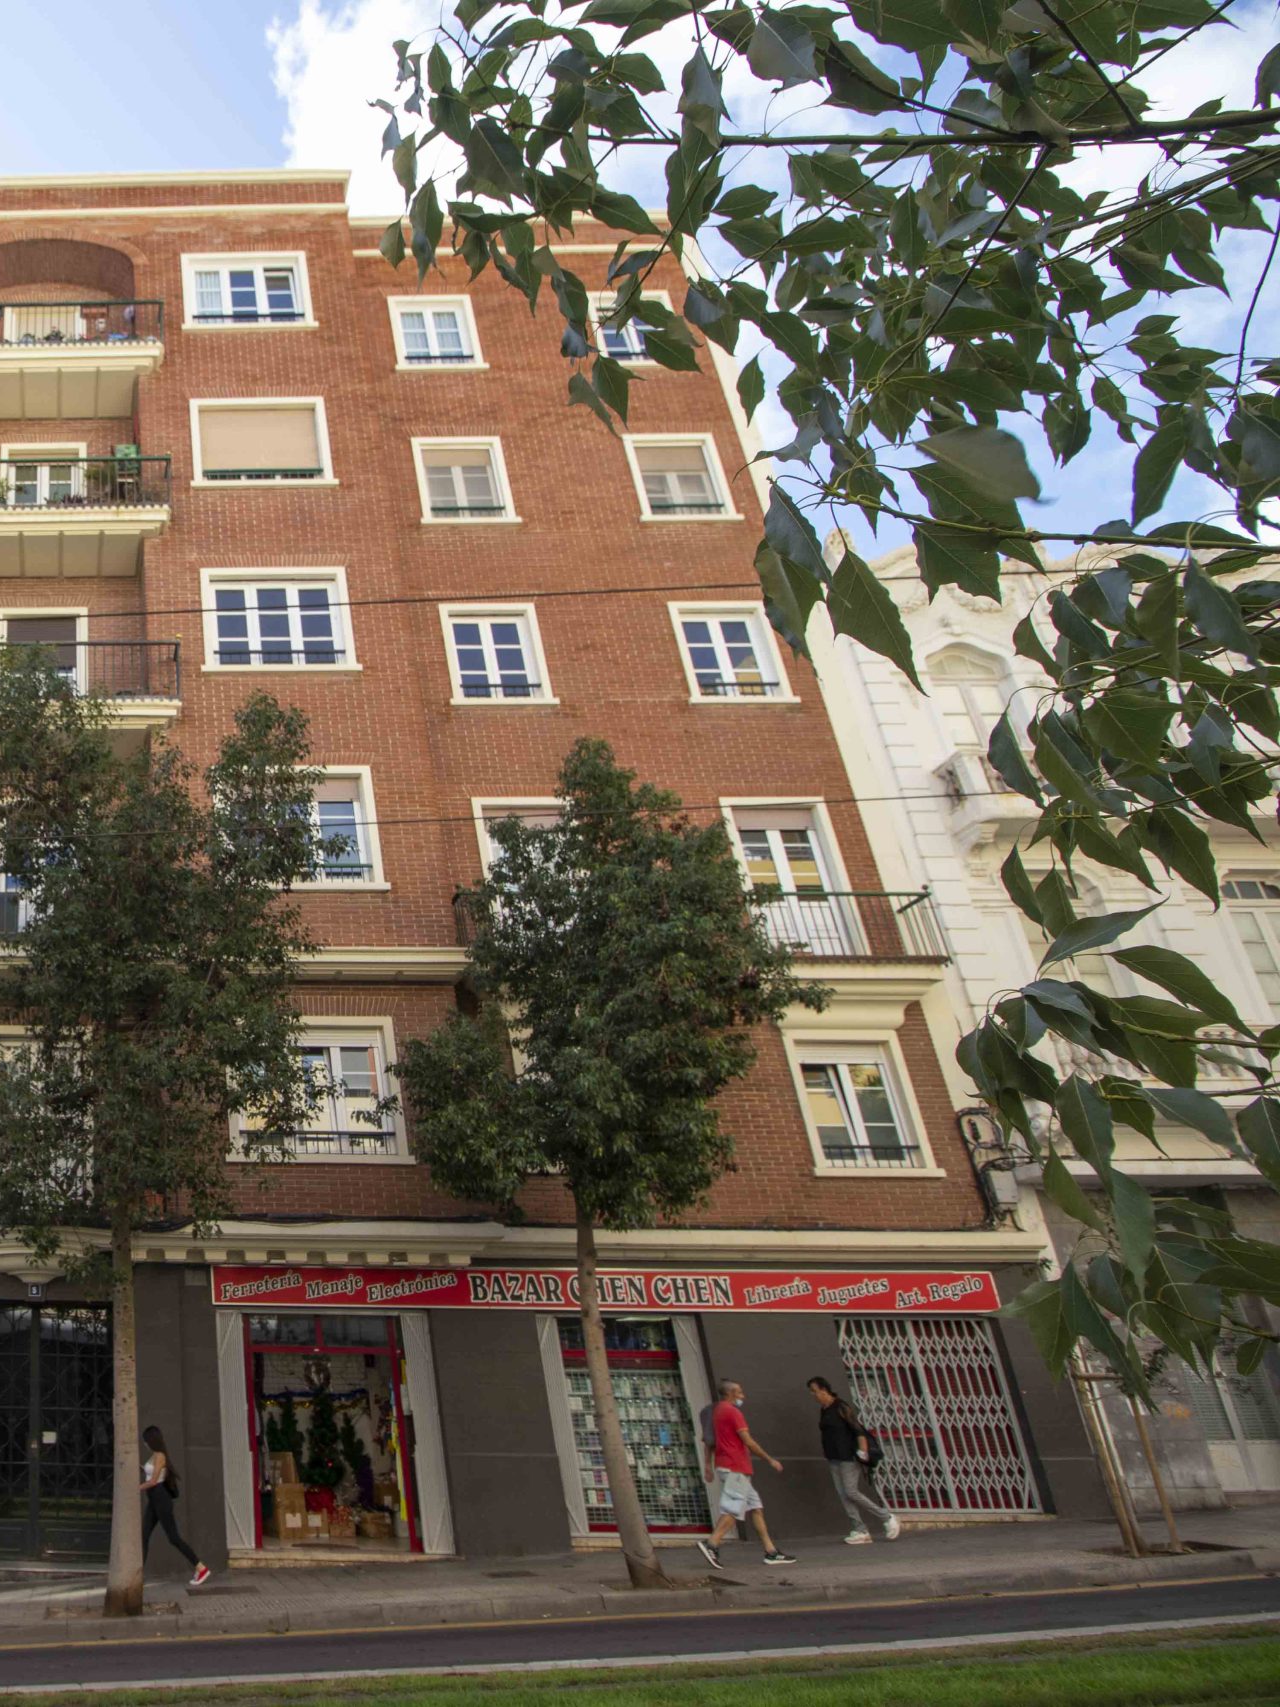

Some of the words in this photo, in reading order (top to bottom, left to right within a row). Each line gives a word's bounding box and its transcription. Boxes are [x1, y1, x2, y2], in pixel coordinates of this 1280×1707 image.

[221, 1269, 302, 1300] Ferretería
[305, 1274, 363, 1300] Menaje
[366, 1271, 457, 1302] Electrónica
[468, 1273, 565, 1305] BAZAR
[651, 1275, 734, 1306] CHEN
[743, 1277, 811, 1305] Librería
[817, 1278, 890, 1305] Juguetes
[895, 1287, 927, 1309] Art.
[927, 1275, 983, 1301] Regalo
